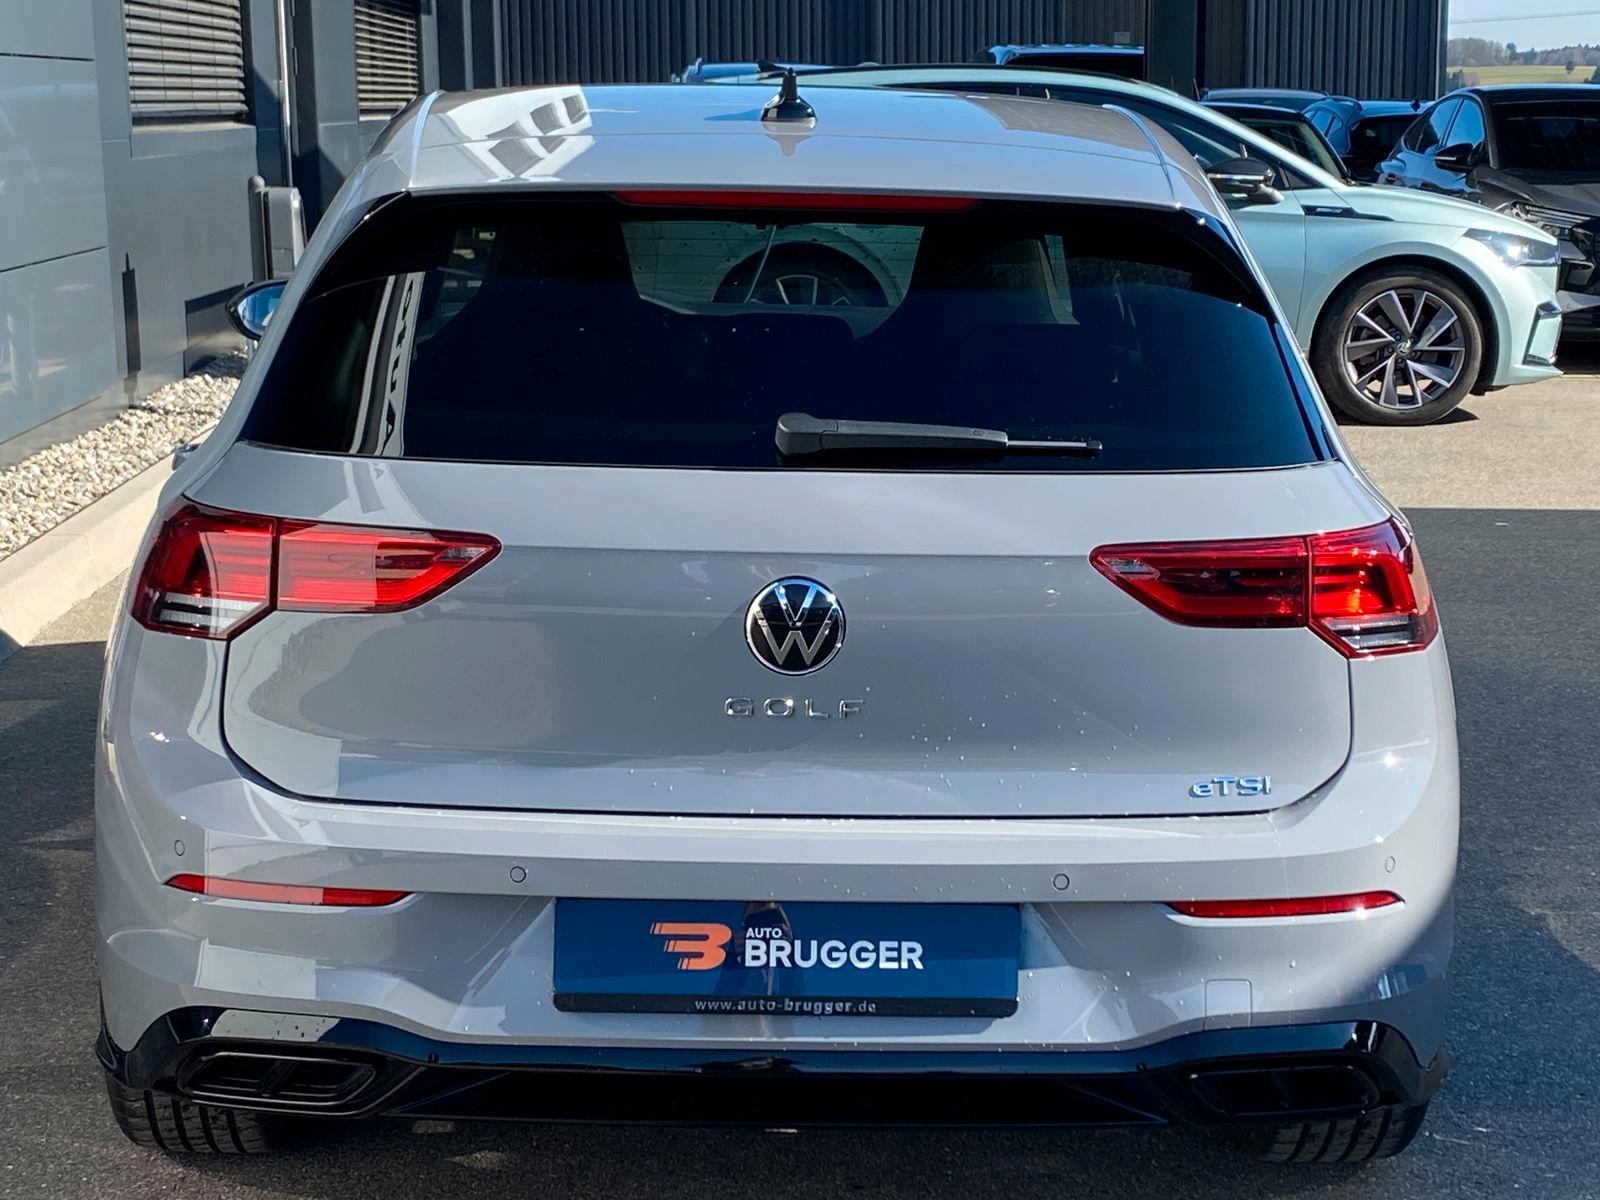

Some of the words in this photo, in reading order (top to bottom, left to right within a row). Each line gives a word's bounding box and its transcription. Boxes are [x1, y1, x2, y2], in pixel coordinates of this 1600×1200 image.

[725, 697, 865, 719] GOLF
[1188, 775, 1271, 798] eTSI
[746, 927, 782, 939] AUTO
[744, 939, 924, 970] BRUGGER
[694, 998, 877, 1015] www.auto-brugger.de
